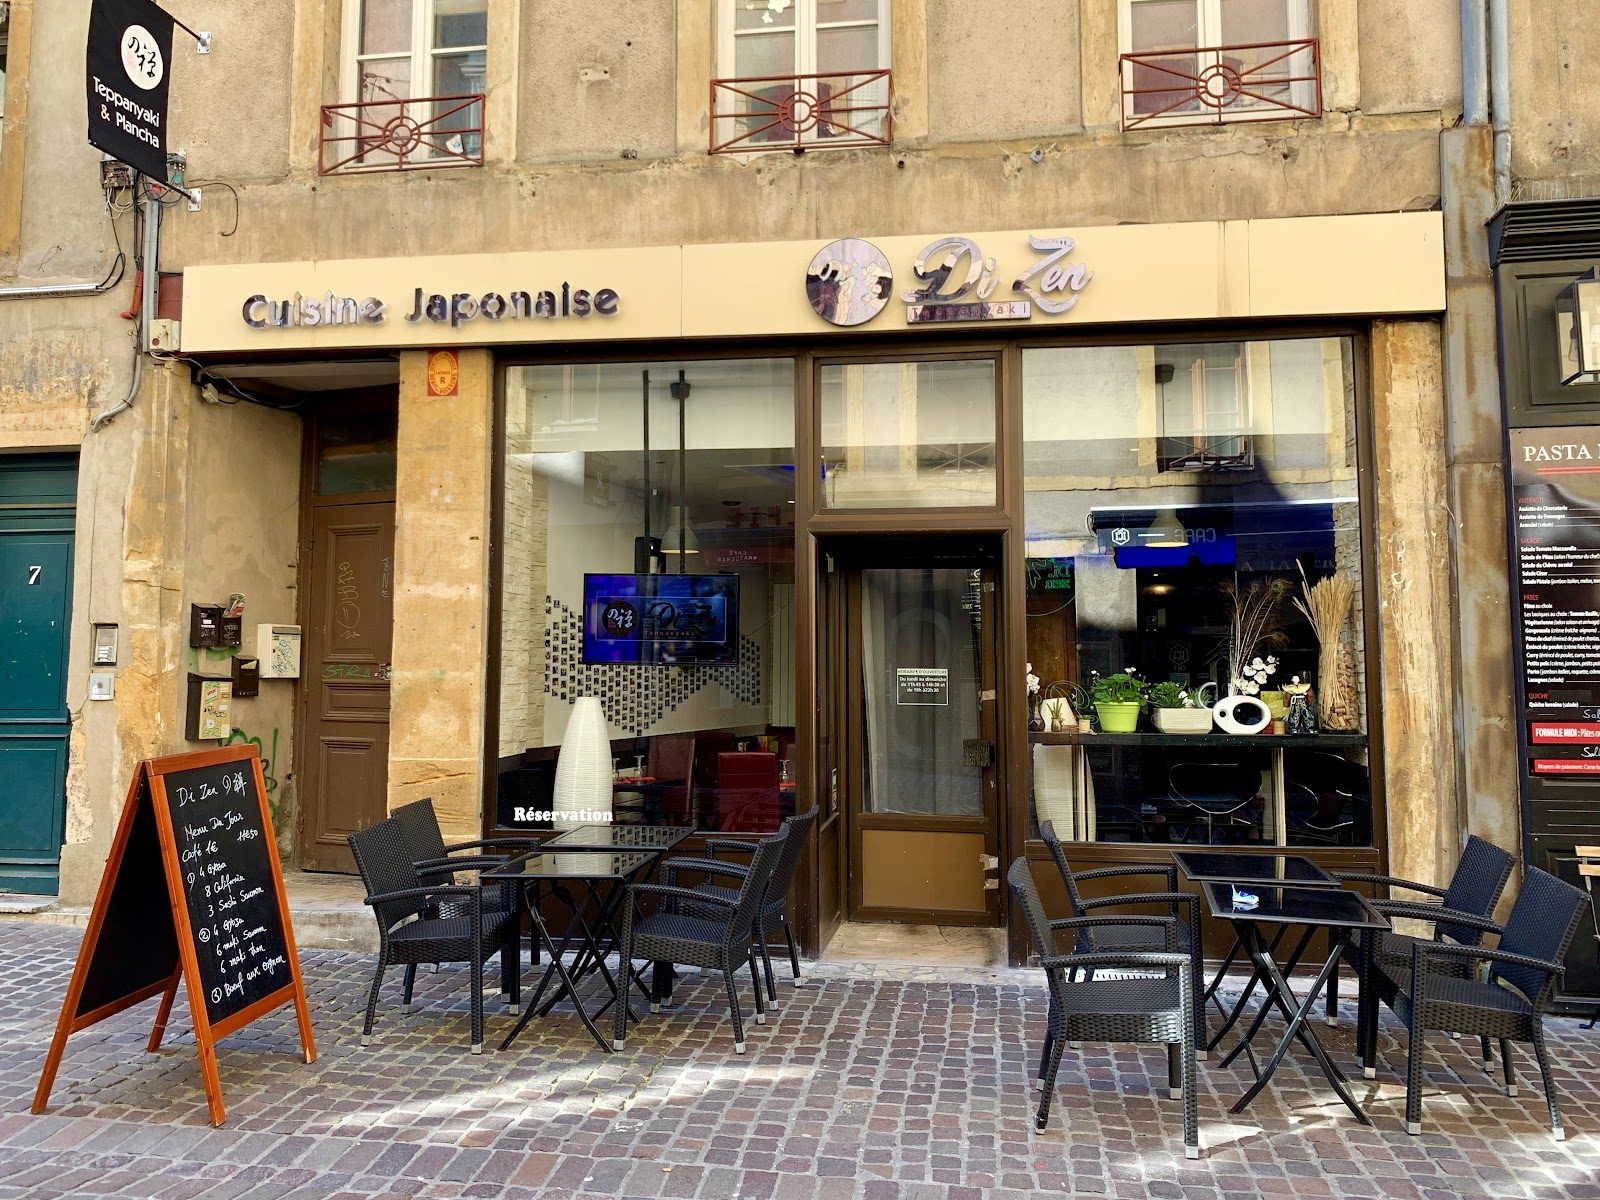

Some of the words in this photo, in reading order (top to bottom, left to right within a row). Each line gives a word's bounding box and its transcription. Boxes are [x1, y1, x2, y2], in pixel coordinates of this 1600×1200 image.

[93, 75, 160, 128] Teppanyaki
[100, 103, 111, 122] &
[115, 111, 160, 149] Plancha
[901, 236, 1000, 303] Di
[1012, 234, 1095, 315] Zen
[242, 289, 386, 329] Cuisine
[404, 280, 620, 328] Japonaise
[1523, 444, 1592, 462] PASTA
[28, 565, 42, 585] 7
[1536, 728, 1563, 737] FORMULE
[1564, 728, 1577, 737] MIDI
[176, 787, 196, 807] Di
[199, 783, 218, 800] Zen
[513, 806, 613, 822] Réservation
[184, 824, 208, 841] Menu
[224, 811, 244, 830] Jour
[182, 843, 202, 862] Café
[200, 866, 205, 877] 4
[204, 885, 211, 897] 8
[208, 905, 214, 917] 3
[213, 924, 219, 936] 4
[216, 943, 222, 956] 6
[223, 934, 240, 950] maki
[220, 960, 226, 973] 6
[229, 949, 246, 966] maki
